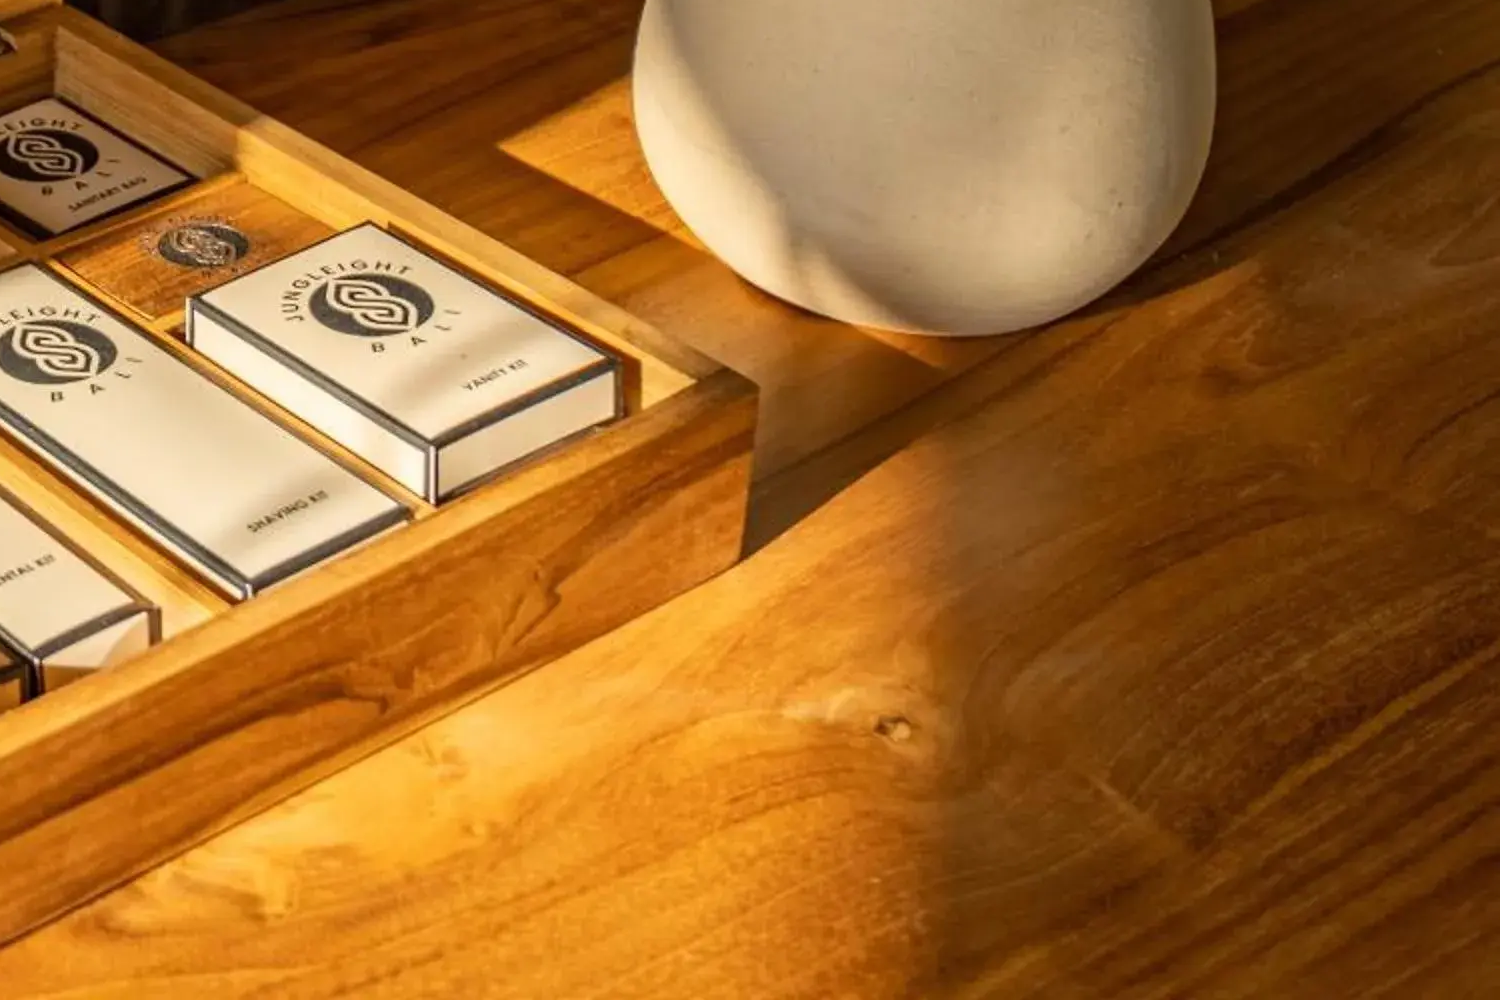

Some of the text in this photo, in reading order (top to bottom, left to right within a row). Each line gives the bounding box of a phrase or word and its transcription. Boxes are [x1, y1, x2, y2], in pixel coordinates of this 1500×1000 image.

[41, 156, 122, 196] BALI
[281, 258, 414, 324] JUNGLEIGHT
[371, 308, 463, 353] BALI
[50, 357, 144, 402] BALI
